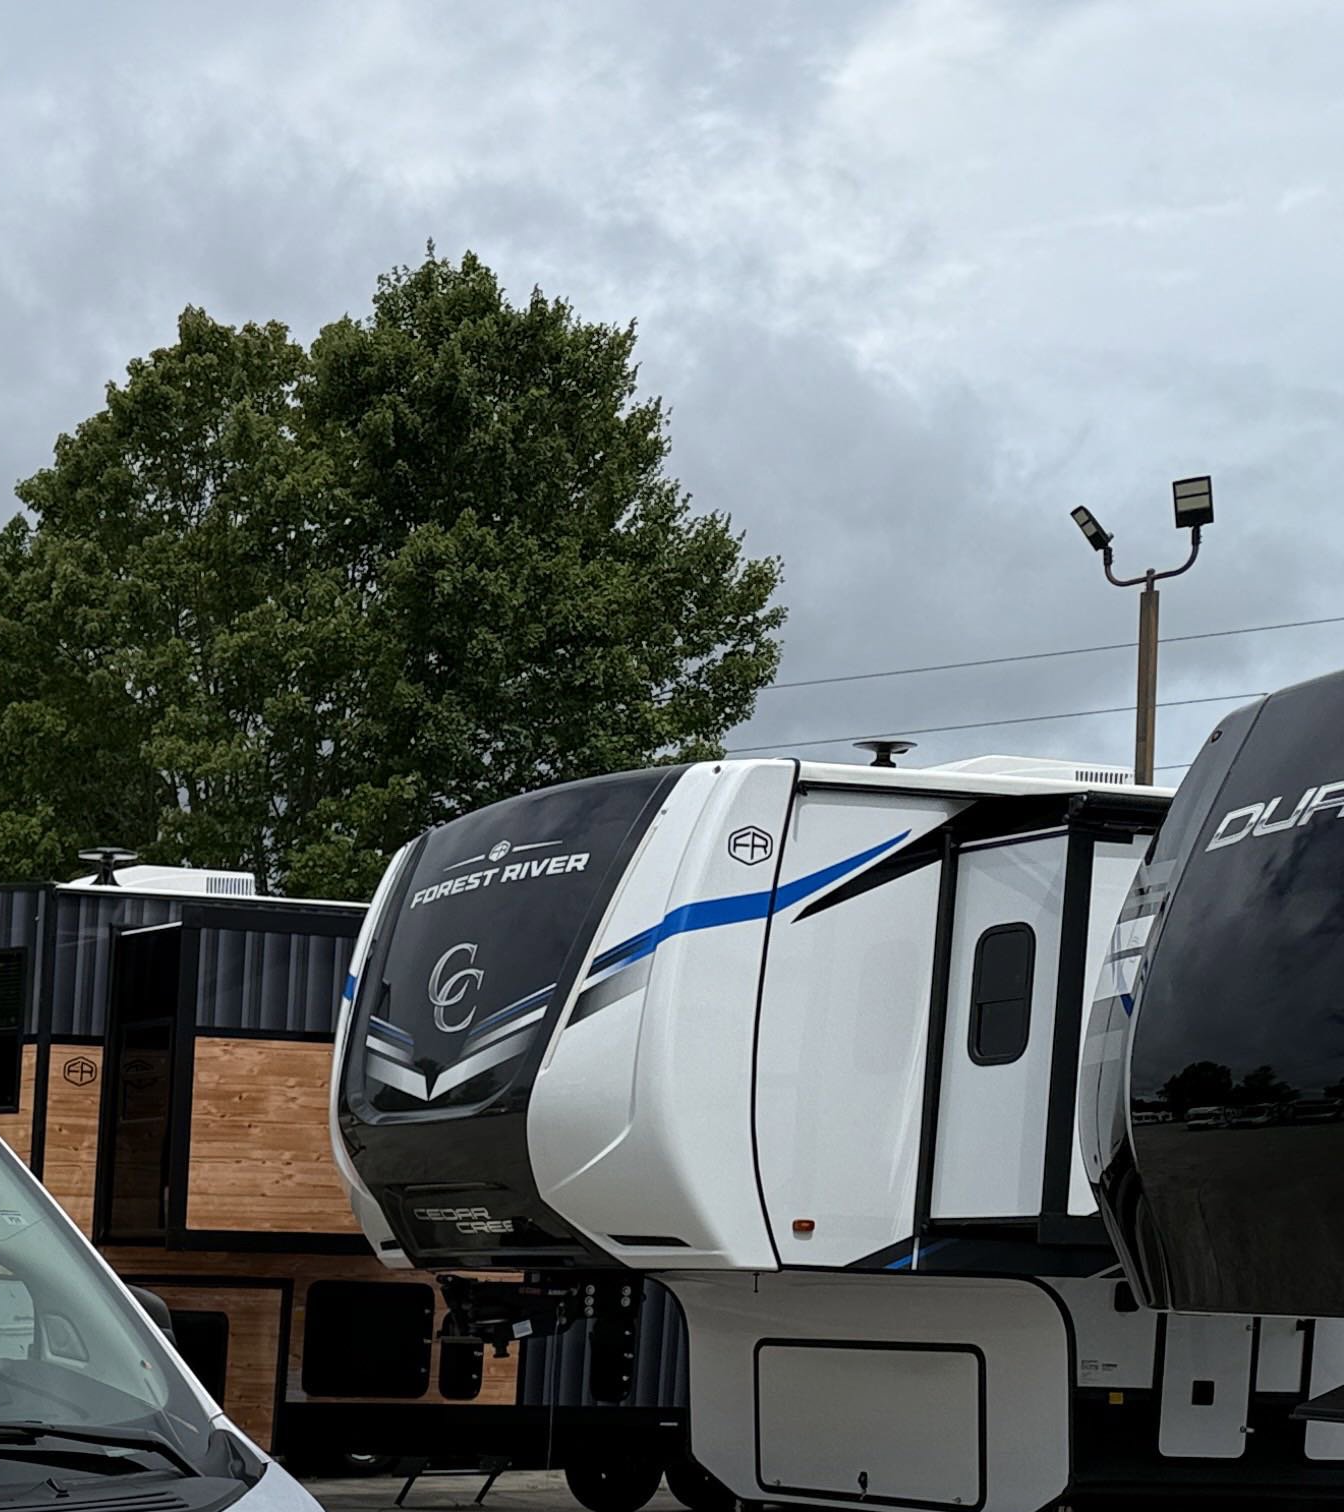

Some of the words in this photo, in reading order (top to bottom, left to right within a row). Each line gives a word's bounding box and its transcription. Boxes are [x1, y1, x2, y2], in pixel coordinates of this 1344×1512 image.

[410, 868, 500, 909] FOREST
[500, 852, 590, 883] RIVER
[413, 1207, 492, 1221] CEDAR
[456, 1219, 515, 1234] CREE
